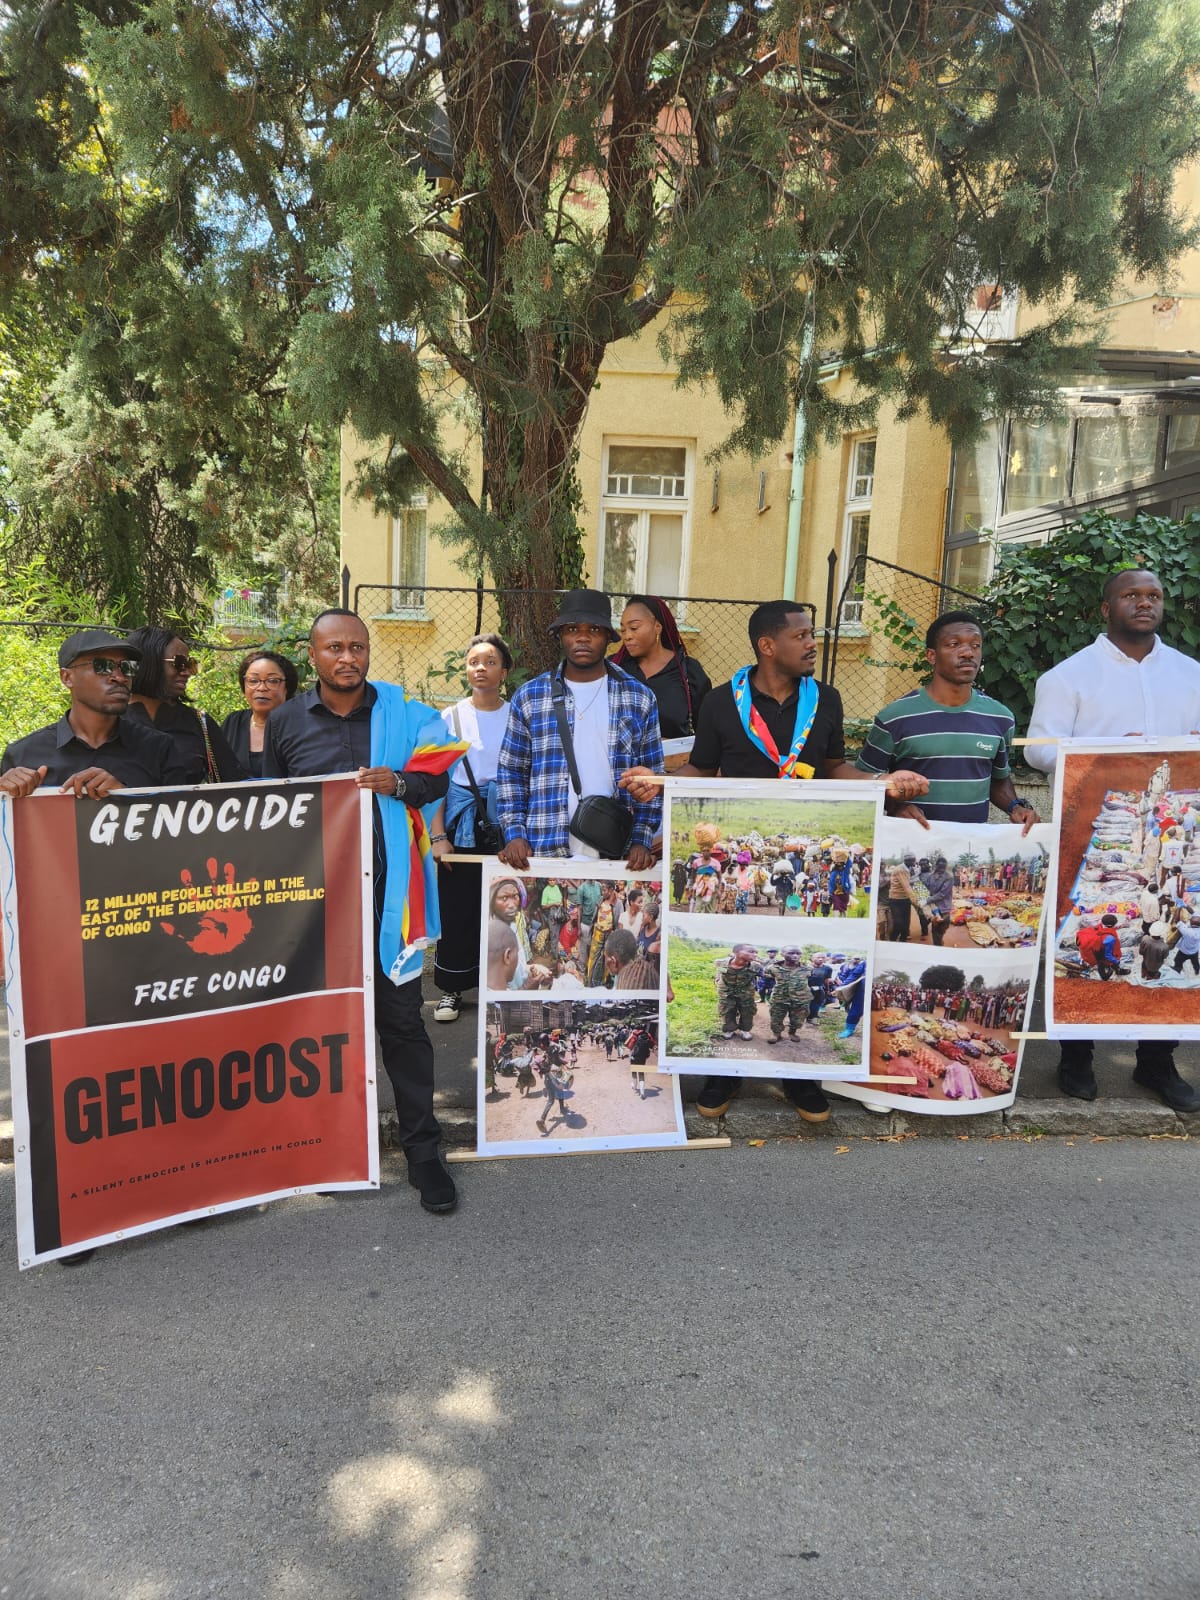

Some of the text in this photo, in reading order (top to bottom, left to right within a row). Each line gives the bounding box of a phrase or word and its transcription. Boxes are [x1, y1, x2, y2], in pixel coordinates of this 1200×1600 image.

[89, 793, 314, 846] GENOCIDE
[81, 888, 325, 926] EAST OF THE DEMOCRATIC REPUBLIC
[85, 876, 305, 911] 12 MILLION PEOPLE KILLED IN THE
[82, 920, 151, 940] OF CONGO
[134, 963, 287, 1006] FREE CONGO
[63, 1033, 349, 1145] GENOCOST
[83, 1180, 124, 1195] SILENT
[129, 1165, 185, 1184] GENOCIDE
[191, 1161, 201, 1169] IS
[205, 1147, 267, 1165] HAPPENING
[287, 1138, 322, 1149] CONGO
